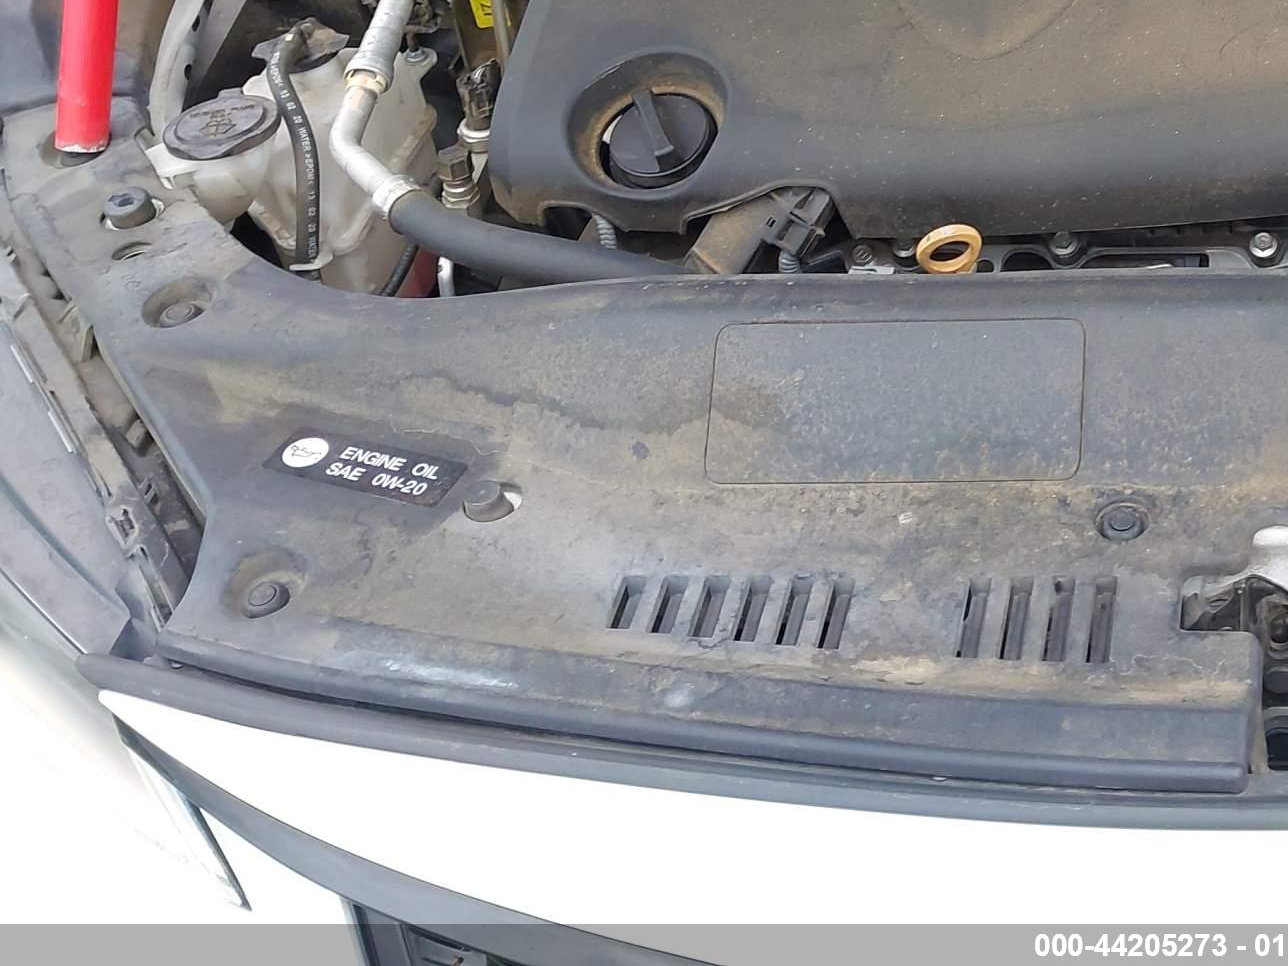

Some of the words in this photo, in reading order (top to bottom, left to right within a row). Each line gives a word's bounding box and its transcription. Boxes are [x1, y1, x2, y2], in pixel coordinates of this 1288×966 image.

[292, 115, 303, 124] 20
[297, 126, 312, 152] WATER
[339, 446, 407, 472] ENGINE
[411, 462, 441, 480] OIL
[325, 462, 366, 482] SAE
[371, 473, 428, 496] 0W-20
